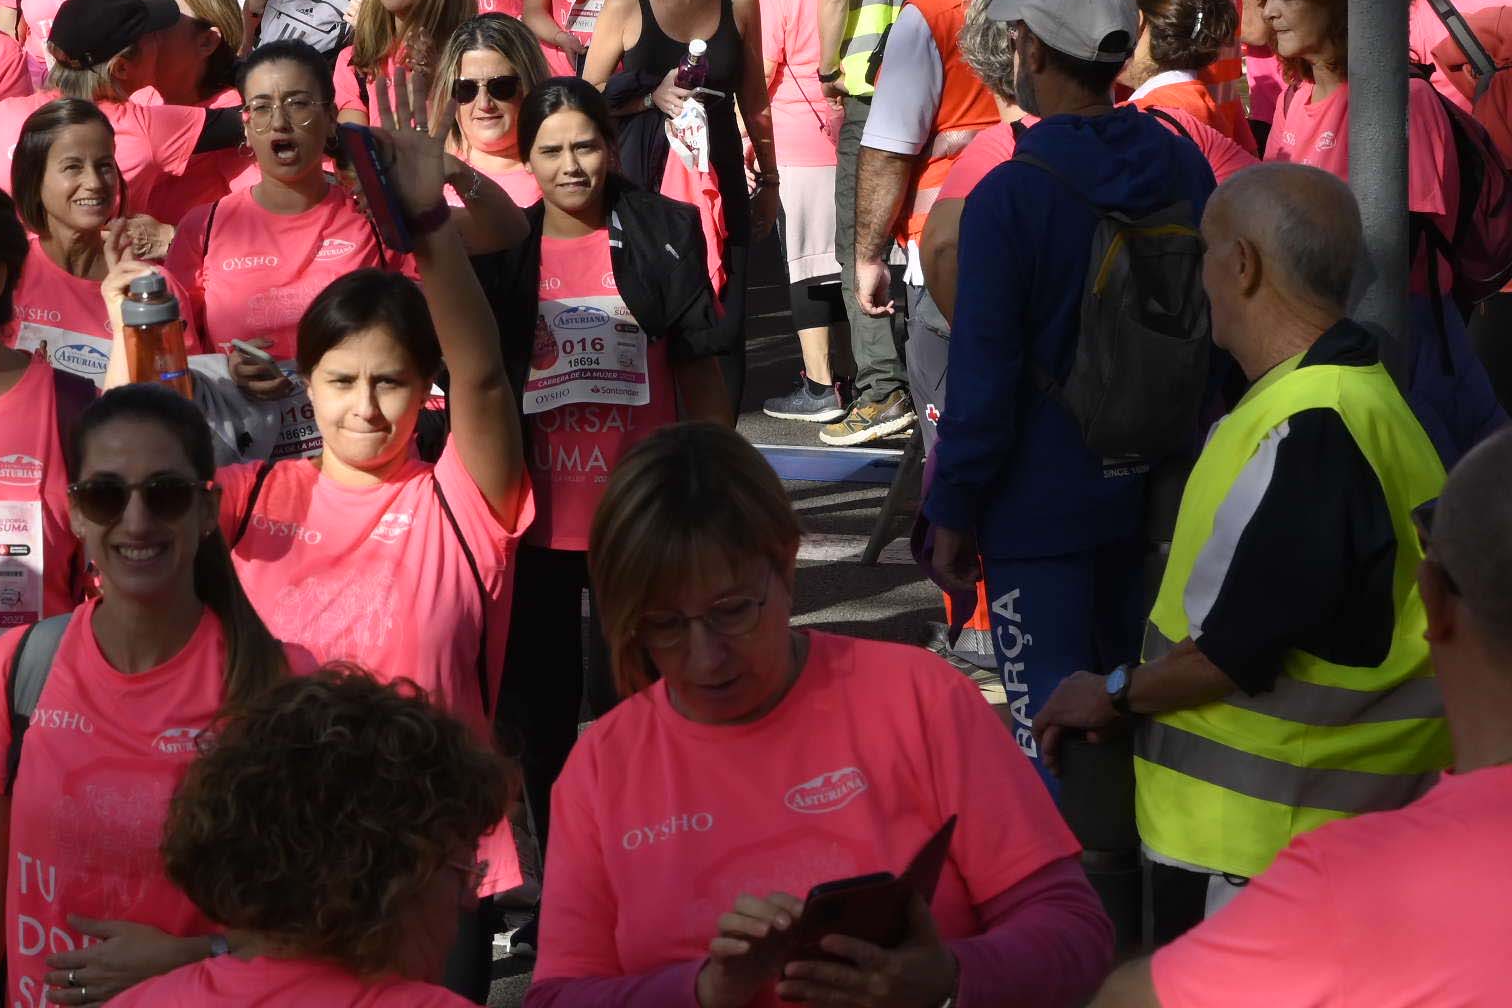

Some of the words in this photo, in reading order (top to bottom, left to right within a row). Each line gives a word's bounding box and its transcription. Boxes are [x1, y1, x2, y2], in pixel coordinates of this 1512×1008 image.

[222, 255, 280, 271] OYSHO
[555, 314, 606, 327] ASTURIANA
[562, 337, 605, 355] 016
[568, 357, 601, 368] 18694
[535, 388, 570, 405] OYSHO
[601, 386, 639, 397] Santander
[534, 443, 609, 473] UMA
[1103, 468, 1130, 478] SINCE
[253, 513, 323, 545] OYSHO
[991, 587, 1039, 759] BARÇA
[793, 772, 864, 812] ASTURIANA
[622, 812, 713, 852] OYSHO
[16, 850, 57, 903] TU
